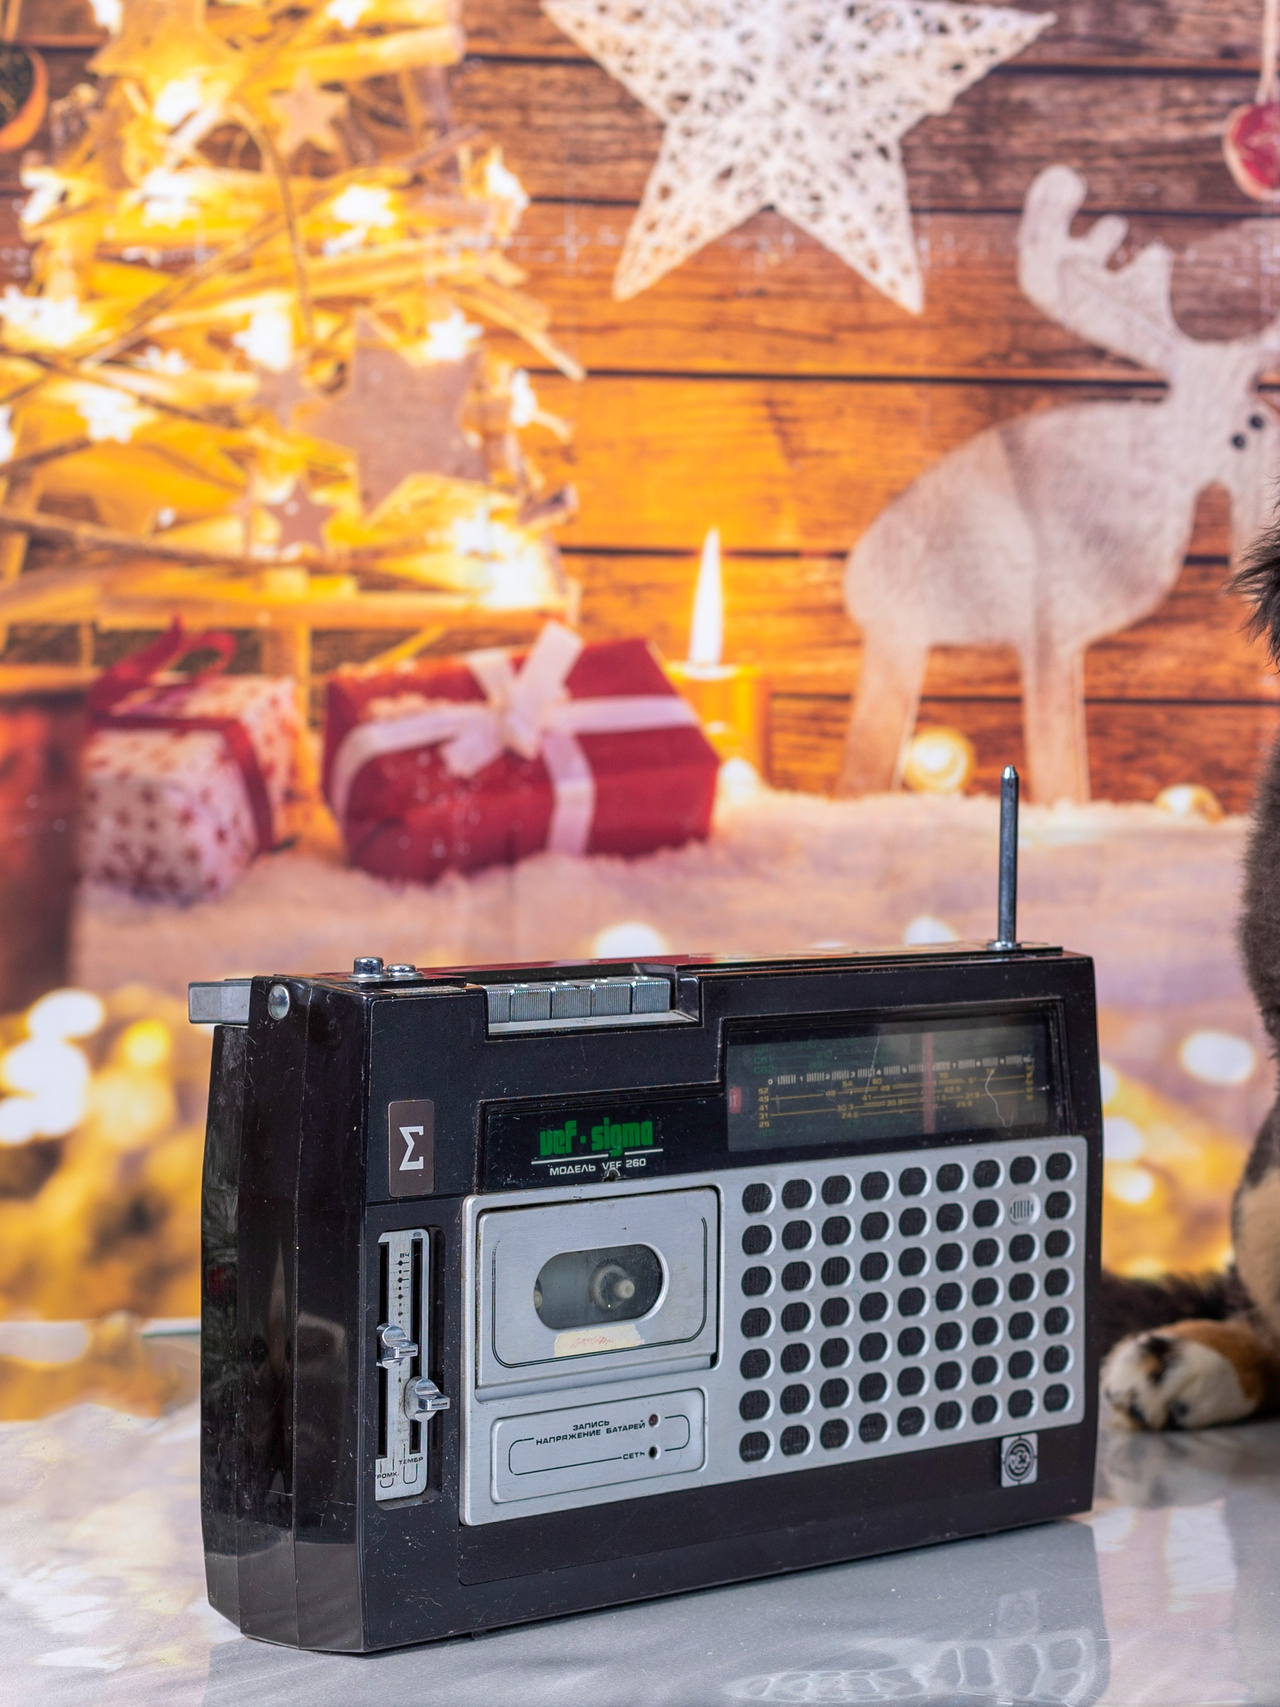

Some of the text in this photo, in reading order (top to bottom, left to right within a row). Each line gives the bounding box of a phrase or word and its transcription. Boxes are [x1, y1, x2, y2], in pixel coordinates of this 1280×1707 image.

[758, 1095, 770, 1103] 49
[759, 1104, 769, 1112] 41
[759, 1112, 769, 1120] 31
[591, 1117, 653, 1157] sigma
[549, 1158, 647, 1176] МОДЕЛЬ VEF 260
[572, 1420, 610, 1431] ЗАПИСЬ
[536, 1419, 646, 1445] НАПРЯЖЕНИЕ БАТАРЕЙ
[399, 1456, 424, 1465] ТЕМБР
